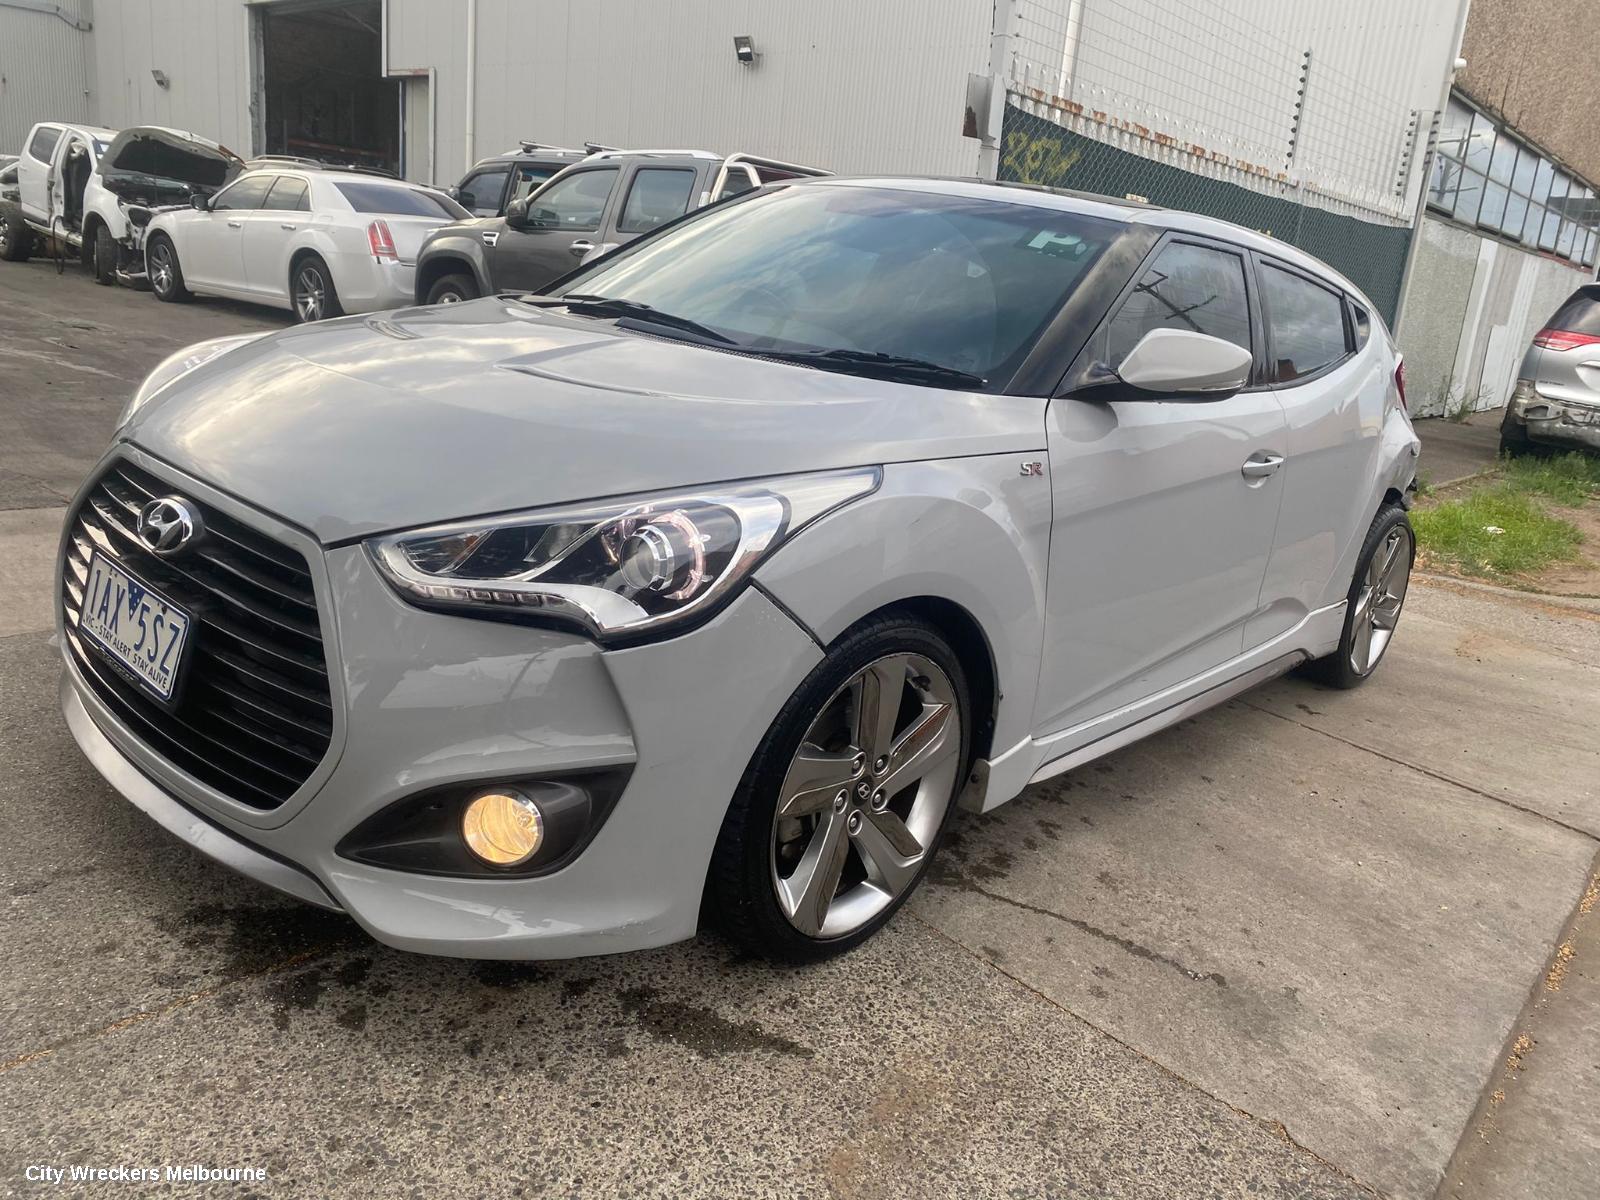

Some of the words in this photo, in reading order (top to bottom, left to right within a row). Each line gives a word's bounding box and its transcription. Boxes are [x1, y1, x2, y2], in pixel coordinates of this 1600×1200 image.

[1020, 462, 1043, 476] SR
[98, 625, 113, 641] STAY
[112, 637, 131, 659] ALERT
[132, 653, 149, 672] STAY
[147, 667, 168, 689] ALIVE
[134, 602, 180, 677] 5SZ
